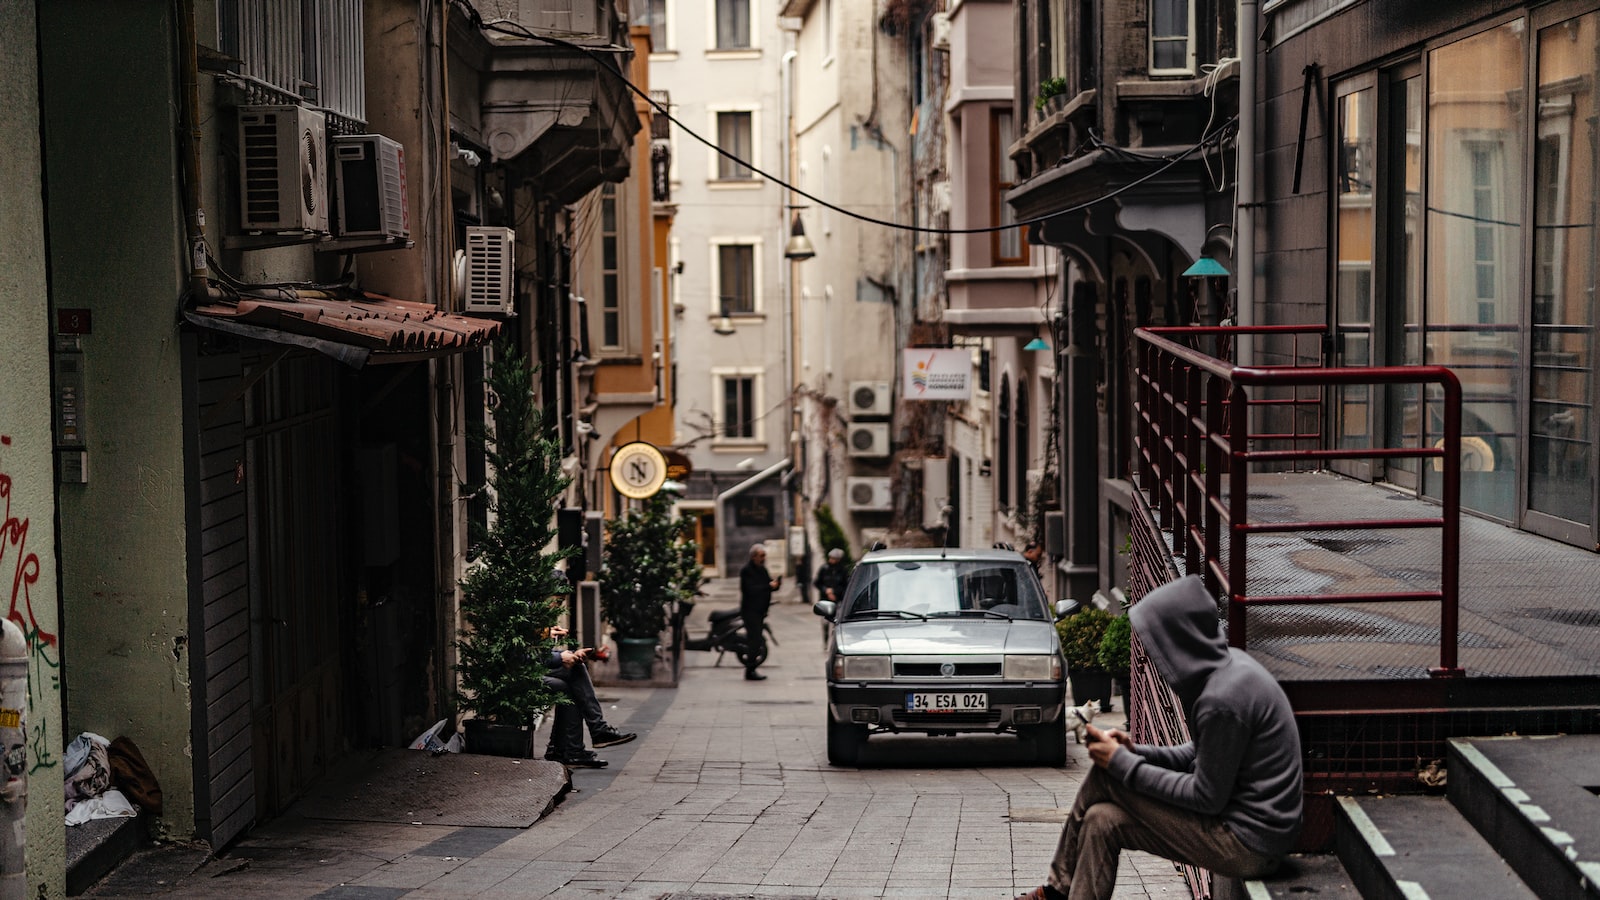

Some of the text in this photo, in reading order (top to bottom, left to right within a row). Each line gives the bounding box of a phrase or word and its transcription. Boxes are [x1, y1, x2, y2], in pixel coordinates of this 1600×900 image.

[71, 314, 79, 328] 3
[914, 694, 985, 708] 34 ESA 024
